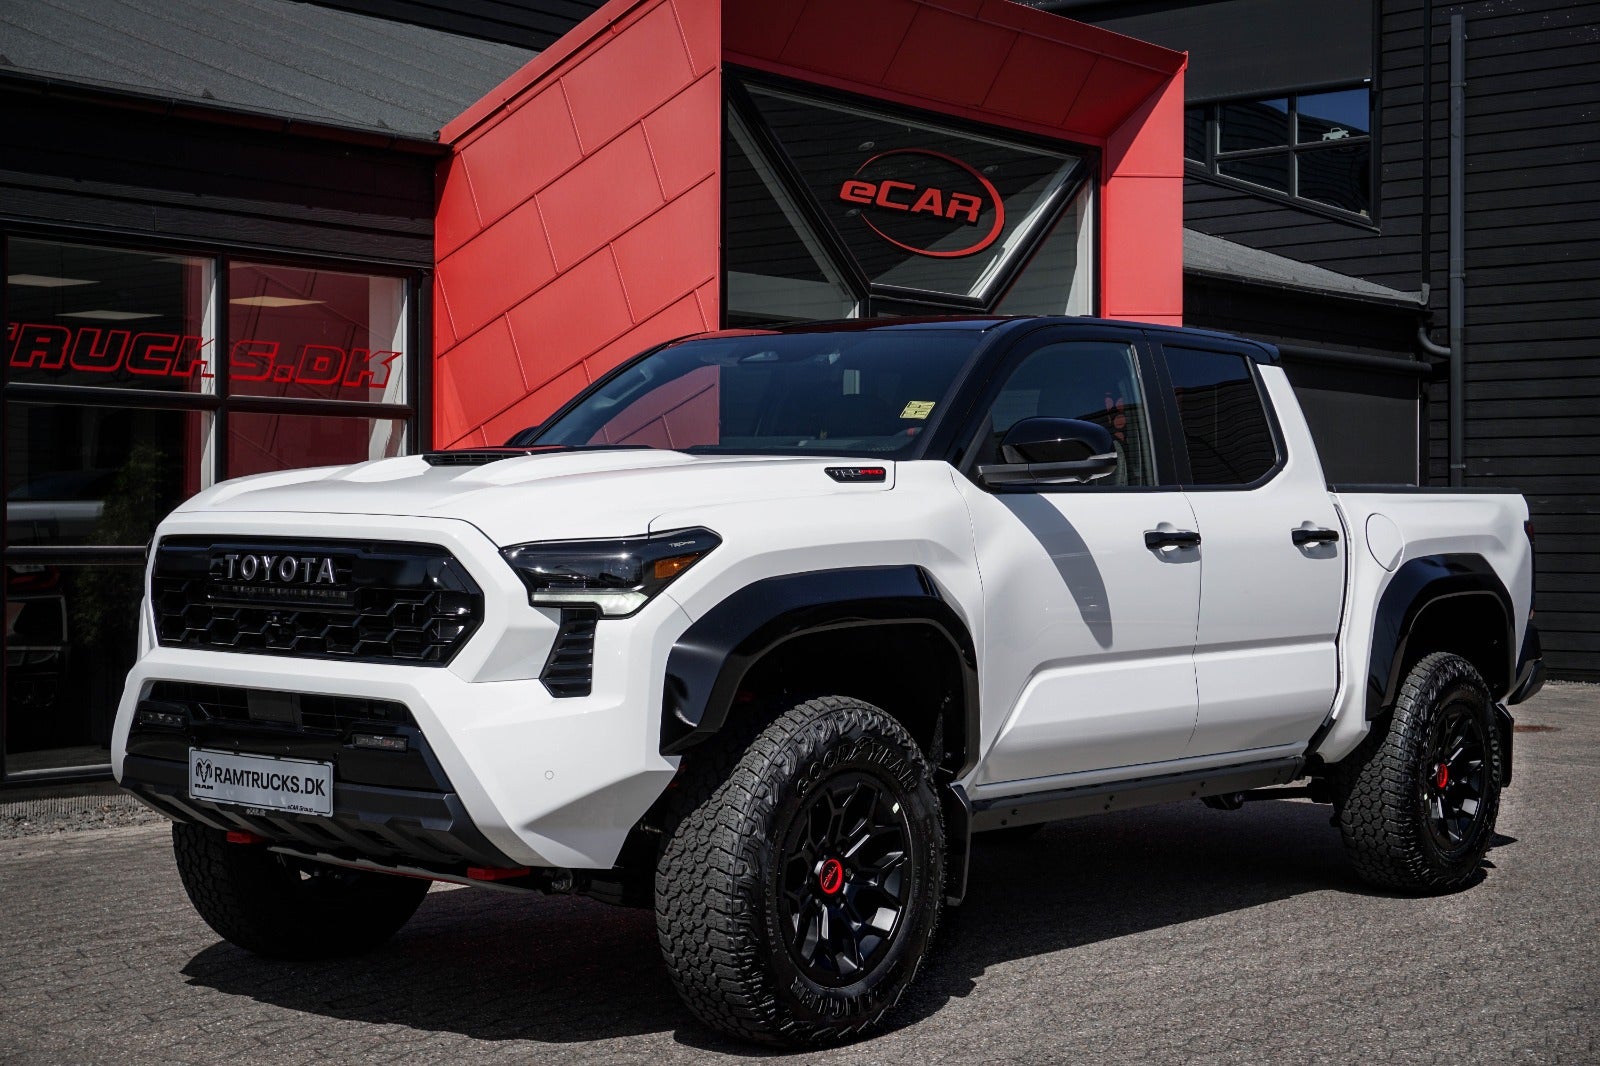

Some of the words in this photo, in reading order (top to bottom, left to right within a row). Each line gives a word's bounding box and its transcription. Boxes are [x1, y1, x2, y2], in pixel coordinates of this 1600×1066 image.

[839, 180, 983, 223] eCAR
[224, 554, 336, 584] TOYOTA
[214, 766, 326, 797] RAMTRUCKS.DK
